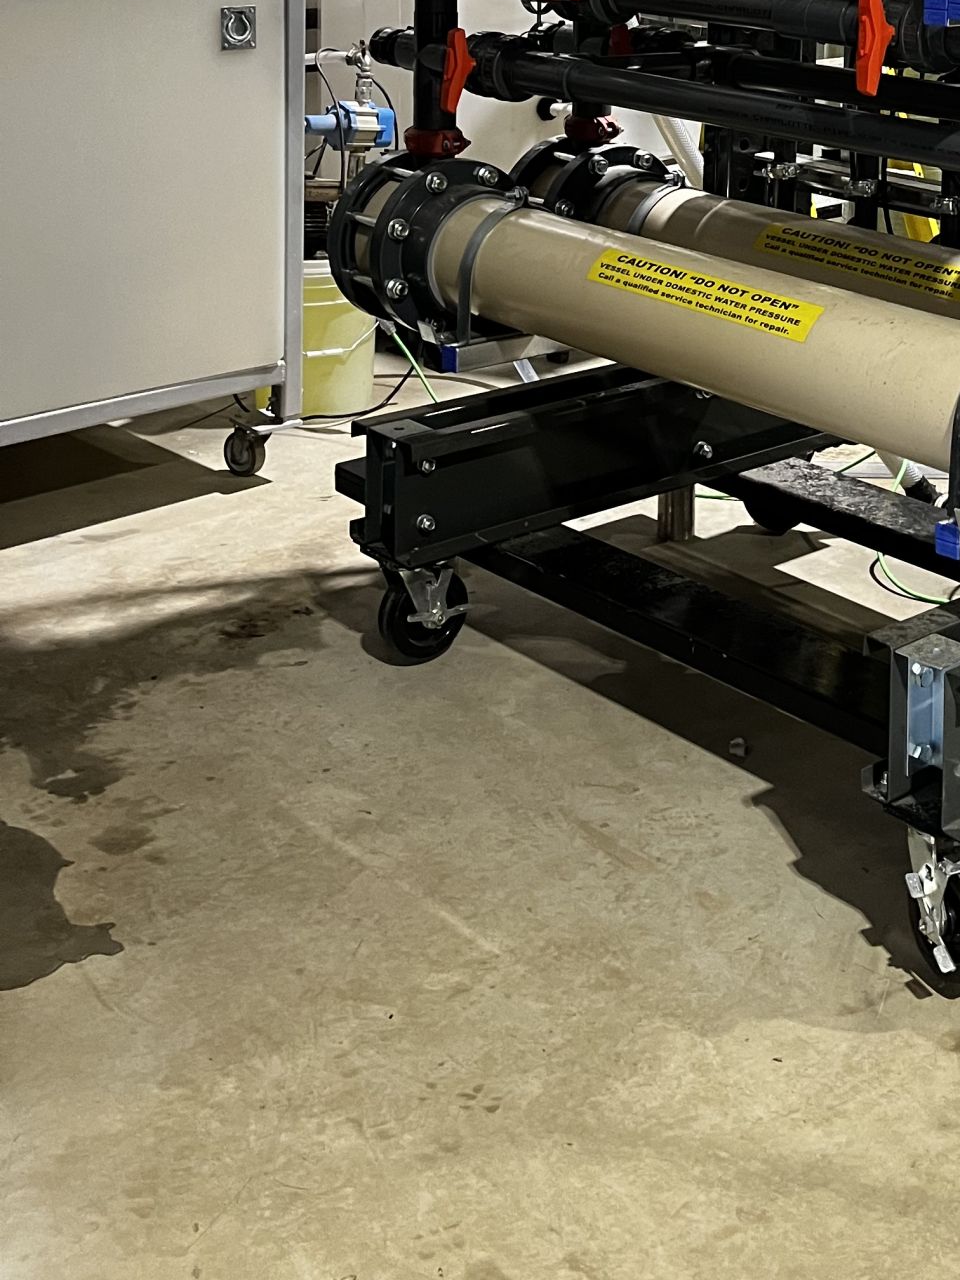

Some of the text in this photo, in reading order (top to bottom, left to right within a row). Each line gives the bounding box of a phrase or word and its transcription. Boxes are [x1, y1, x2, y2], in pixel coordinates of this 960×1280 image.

[764, 242, 780, 251] Call
[788, 250, 825, 263] qualified
[826, 260, 859, 272] service
[860, 268, 907, 285] technician
[909, 281, 923, 289] for
[924, 285, 954, 298] repair.
[766, 234, 796, 247] VESSEL
[798, 242, 829, 255] UNDER
[830, 251, 877, 267] DOMESTIC
[879, 263, 911, 276] WATER
[781, 227, 852, 250] CAUTION!
[881, 252, 913, 265] NOT
[600, 262, 801, 327] VESSEL UNDER DOMESTIC WATER PRESSURE
[617, 255, 688, 280] CAUTION!
[717, 284, 749, 298] NOT
[598, 272, 614, 281] Call
[622, 281, 660, 295] qualified
[660, 291, 693, 305] service
[695, 301, 742, 321] technician
[744, 315, 758, 326] for
[759, 321, 789, 335] repair.
